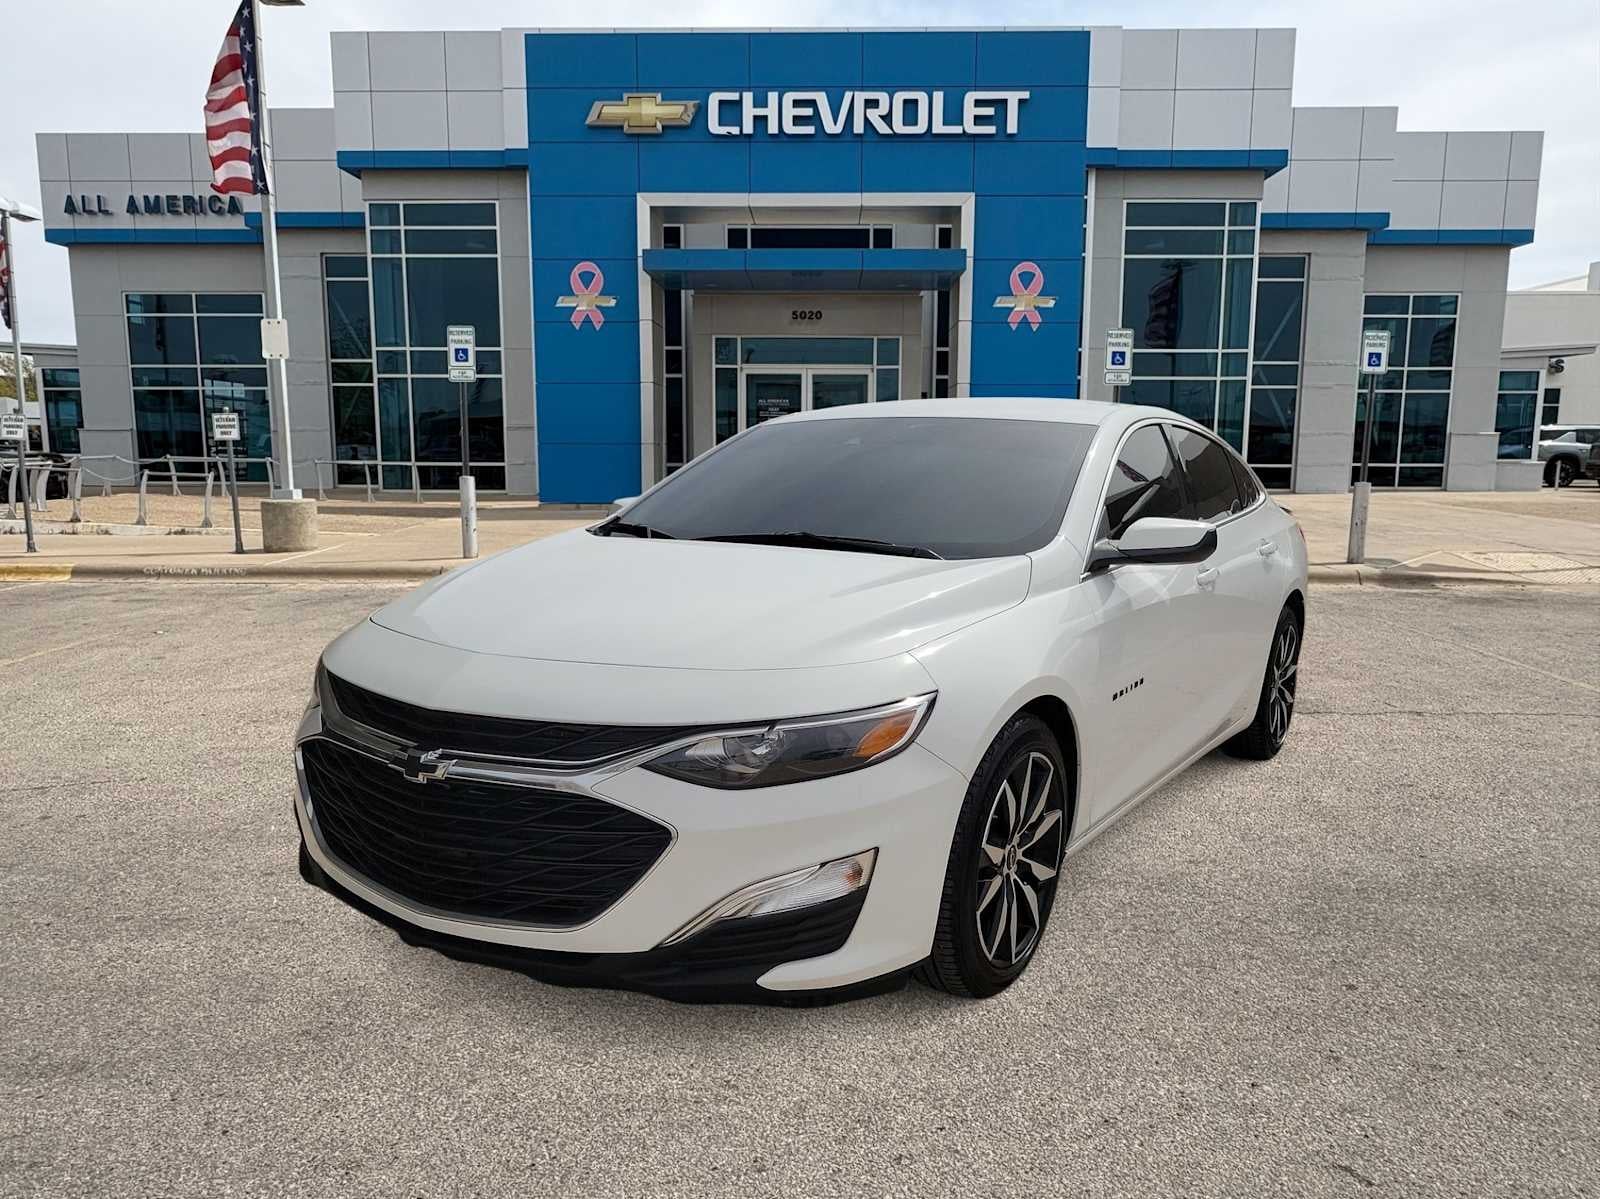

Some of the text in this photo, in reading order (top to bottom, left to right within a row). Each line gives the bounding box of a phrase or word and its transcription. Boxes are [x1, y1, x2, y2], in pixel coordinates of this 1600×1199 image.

[707, 91, 1030, 135] CHEVROLET
[63, 194, 242, 215] ALL AMERICA
[791, 310, 823, 320] 5020
